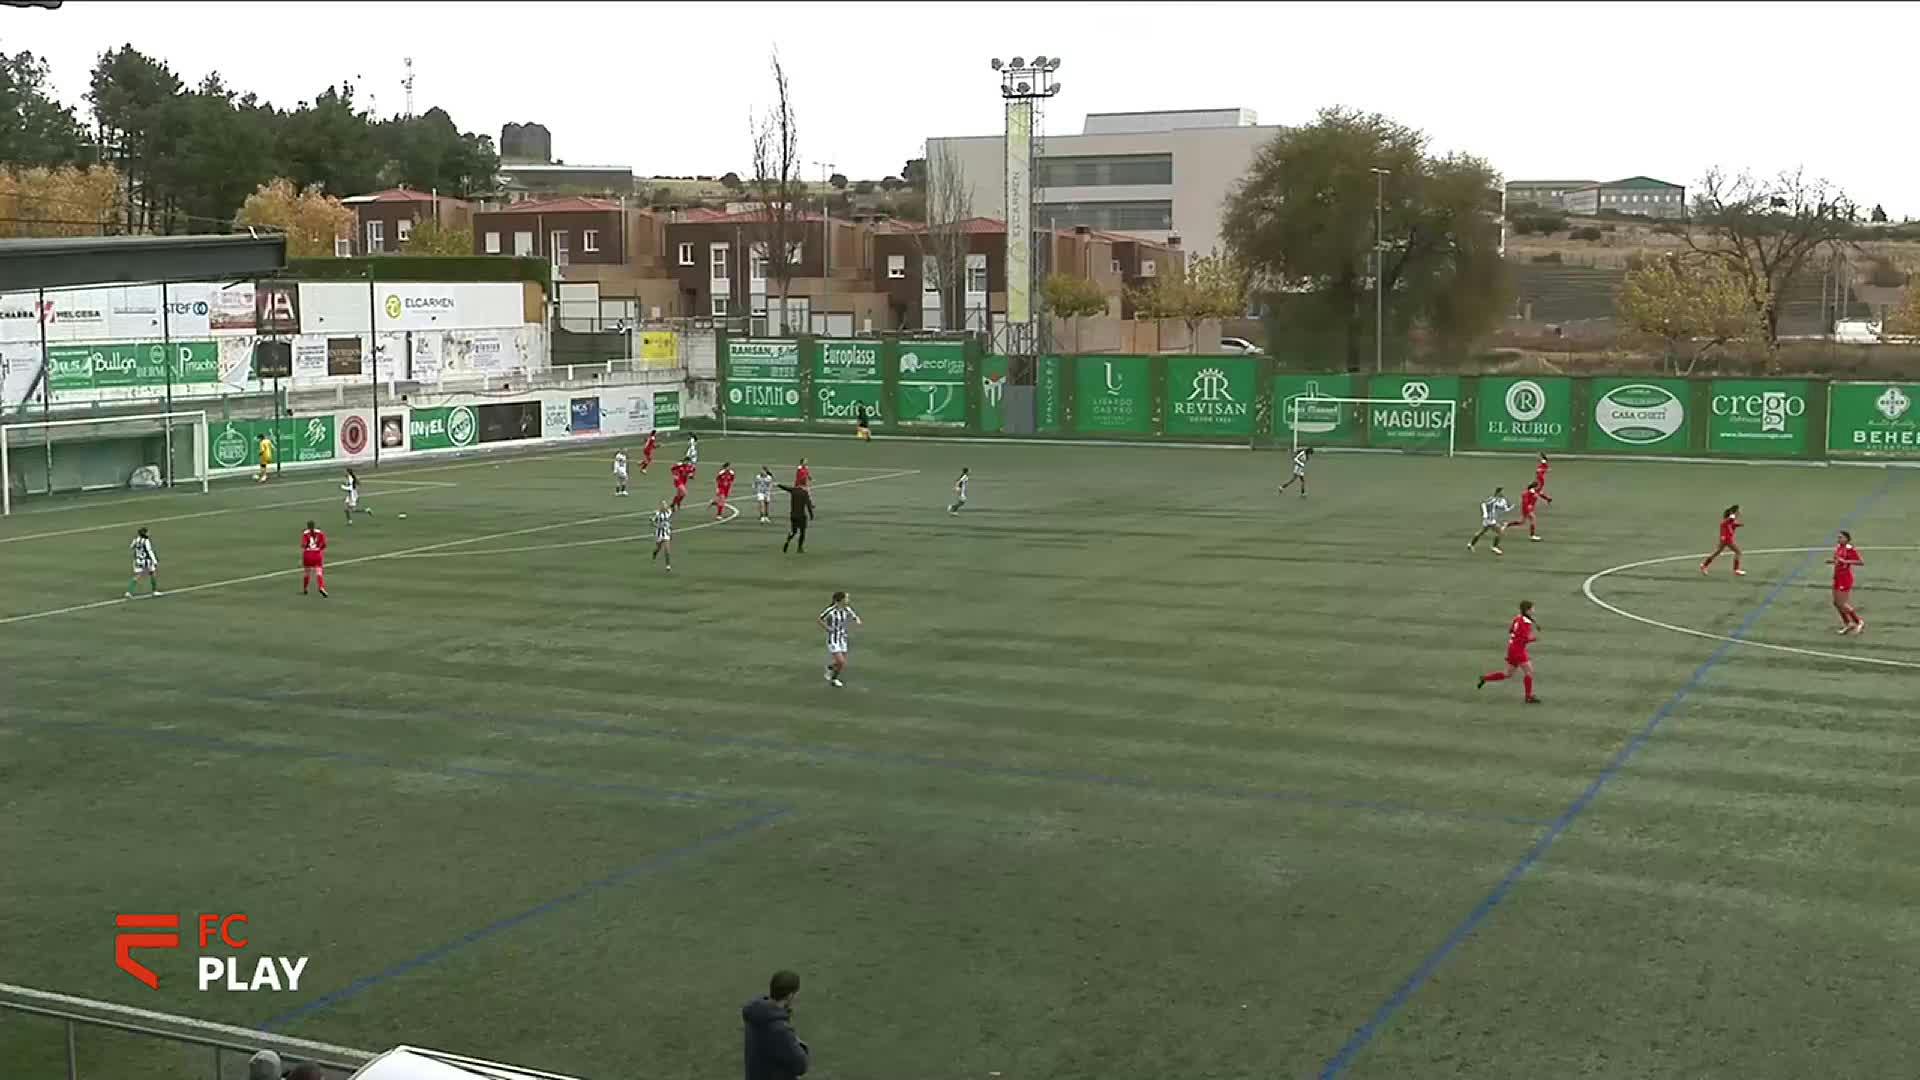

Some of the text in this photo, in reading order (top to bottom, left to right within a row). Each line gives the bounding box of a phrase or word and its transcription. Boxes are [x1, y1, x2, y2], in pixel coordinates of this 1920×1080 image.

[1175, 402, 1247, 415] REVISAN
[1712, 392, 1806, 431] crego
[1374, 410, 1454, 429] MAGUISA
[1488, 421, 1562, 435] EL RUBIO
